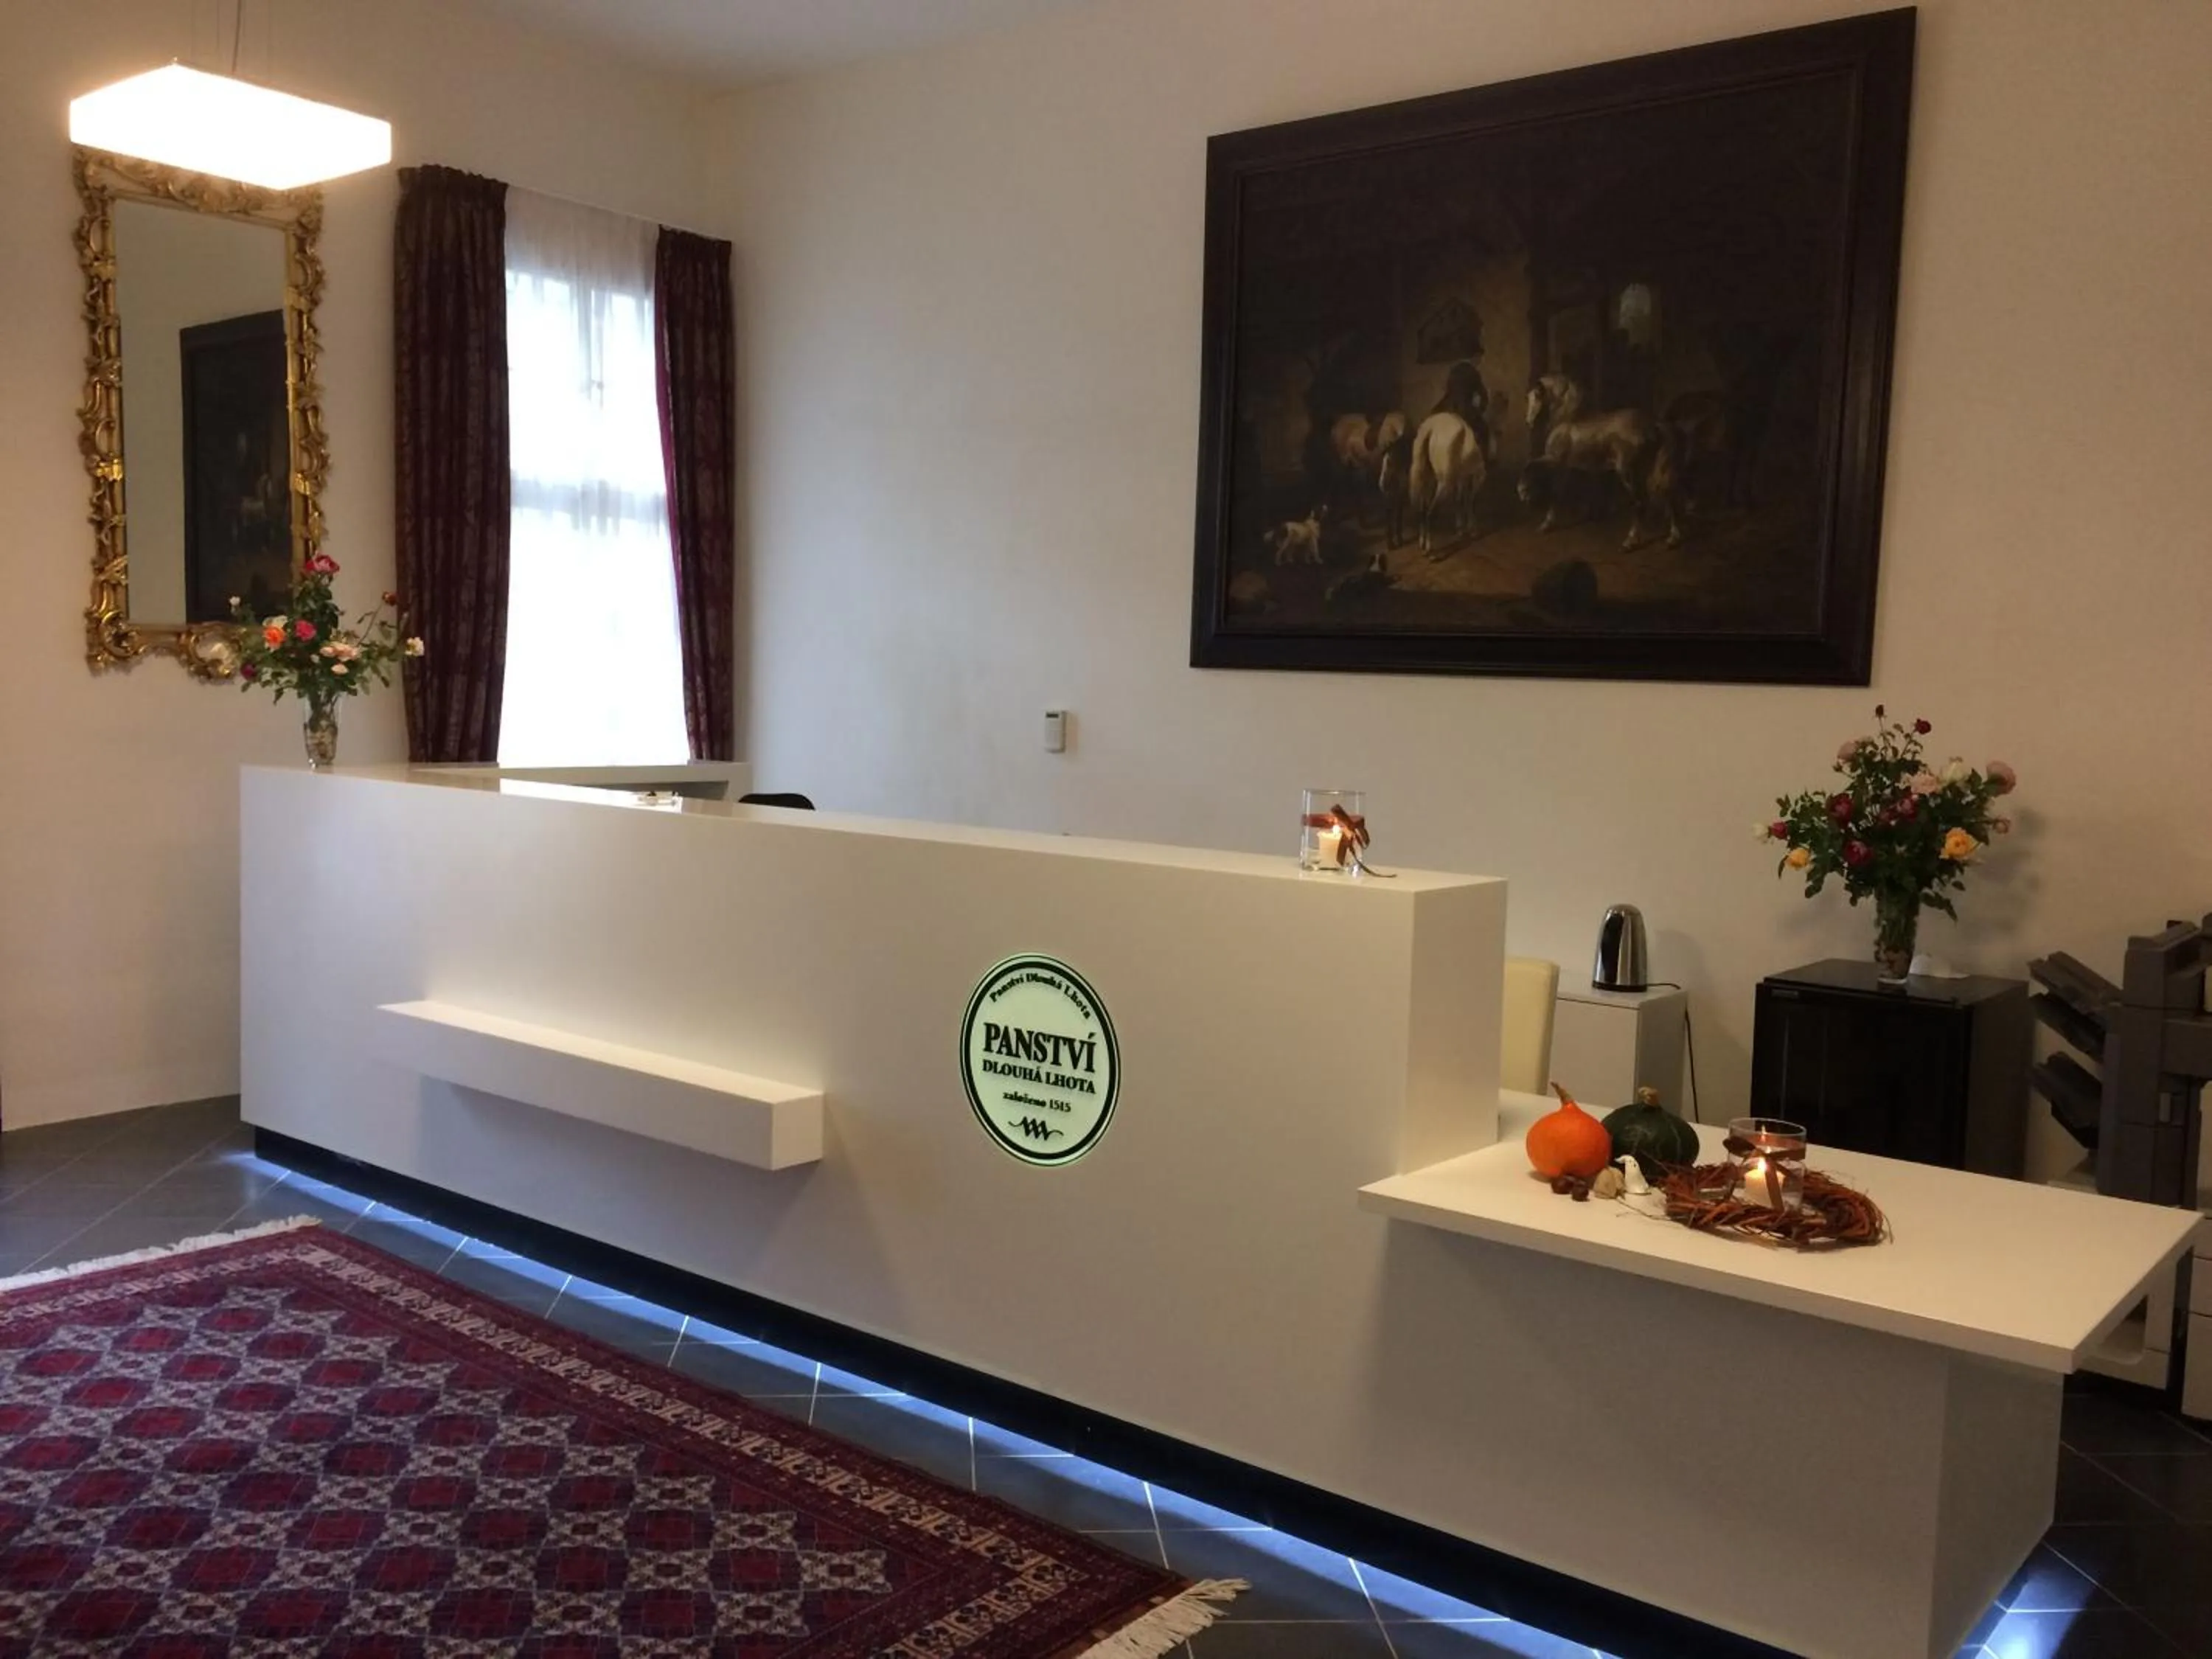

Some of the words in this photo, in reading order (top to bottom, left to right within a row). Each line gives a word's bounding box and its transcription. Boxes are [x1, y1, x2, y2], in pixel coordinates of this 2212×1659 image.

[1064, 984, 1091, 1020] Lhota
[983, 1022, 1097, 1074] PANSTVÍ
[982, 1060, 1043, 1084] DLOUHÁ
[1045, 1071, 1096, 1093] LHOTA
[1049, 1099, 1071, 1113] 1515
